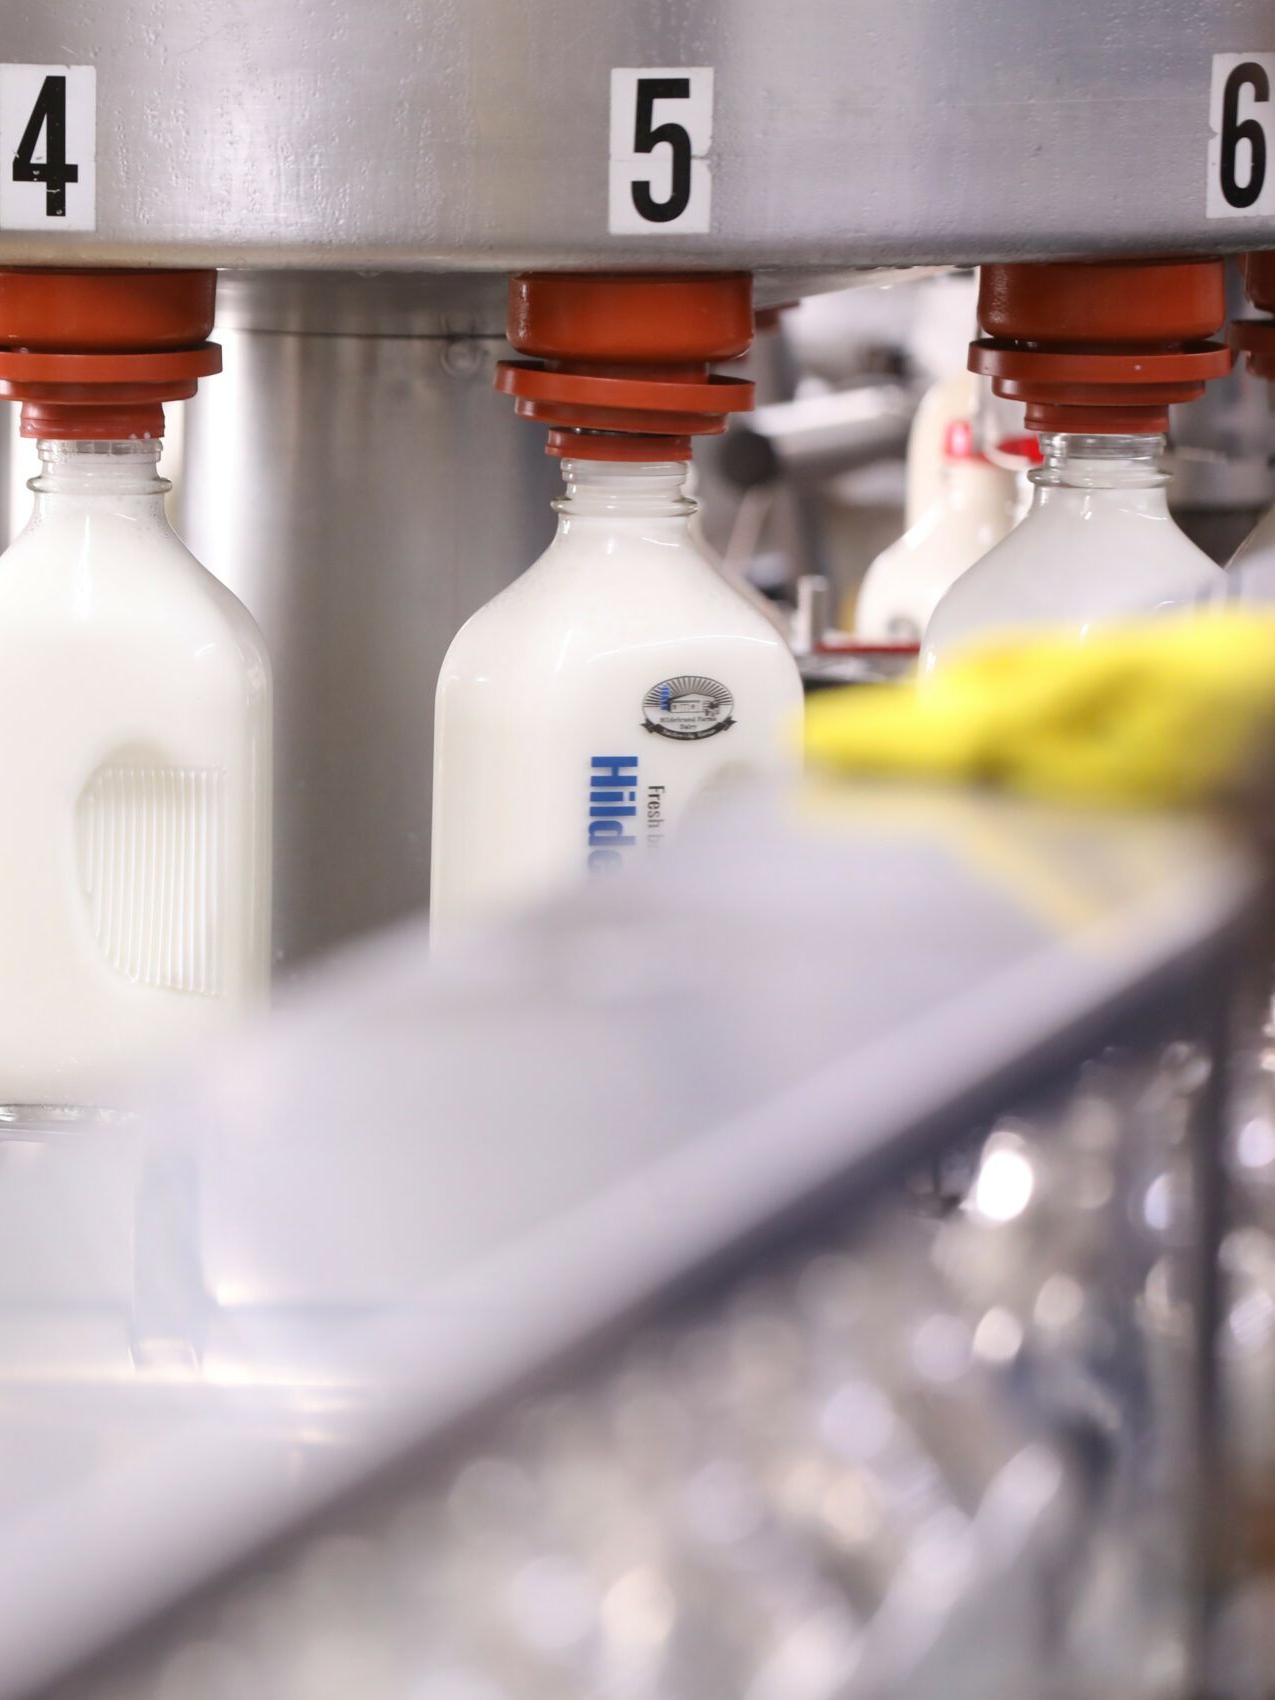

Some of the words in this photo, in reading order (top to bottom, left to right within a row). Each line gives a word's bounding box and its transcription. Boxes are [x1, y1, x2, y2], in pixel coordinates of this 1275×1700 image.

[12, 76, 78, 216] 4
[630, 78, 691, 223] 5
[1219, 61, 1270, 208] 6
[647, 785, 665, 828] Fresh
